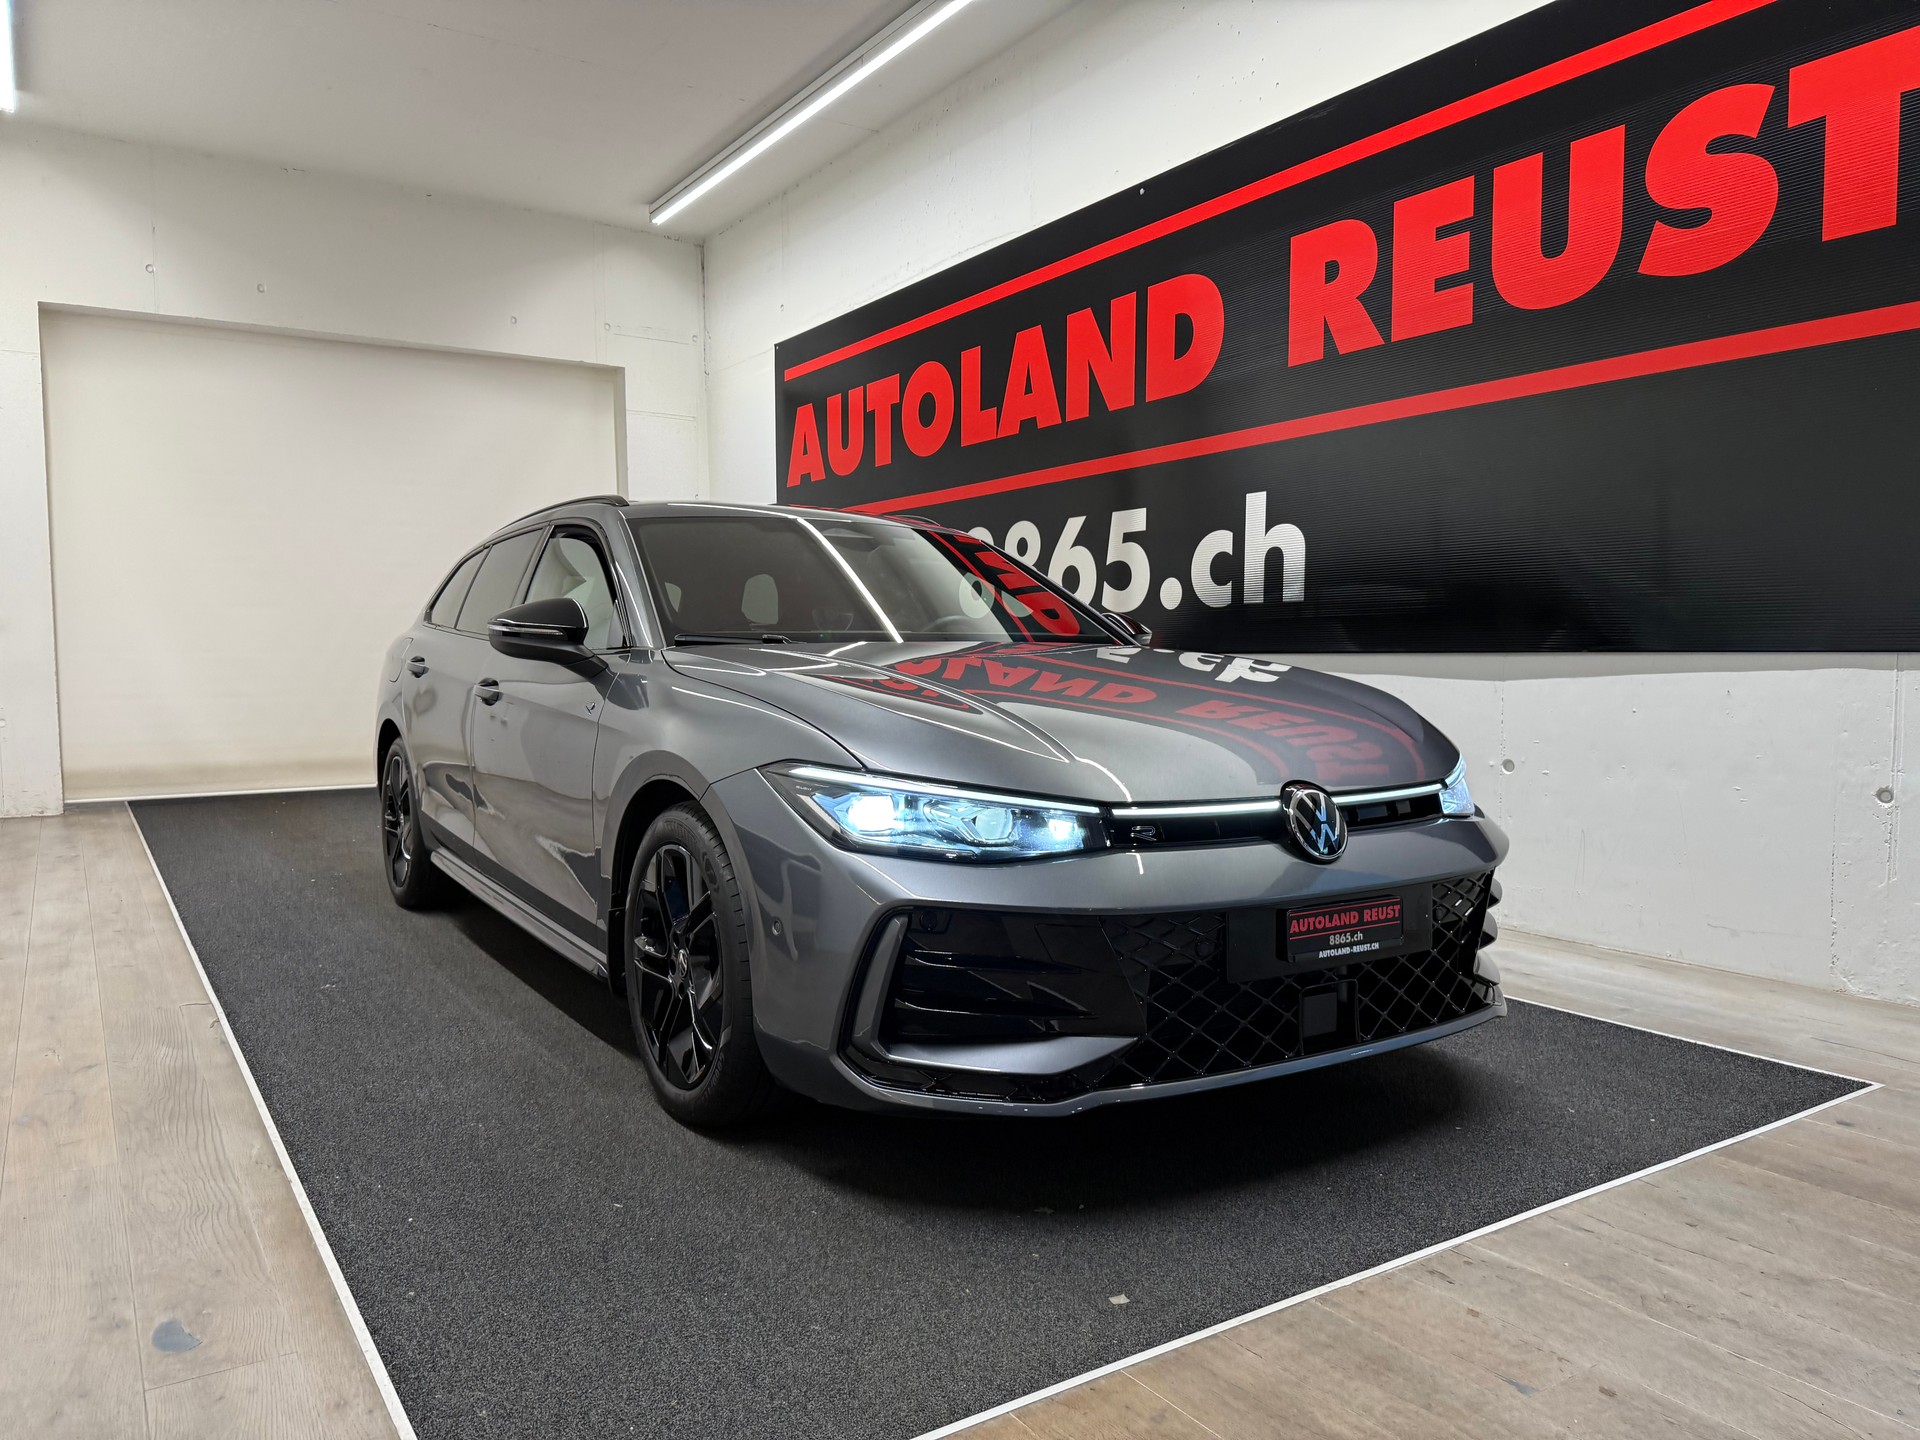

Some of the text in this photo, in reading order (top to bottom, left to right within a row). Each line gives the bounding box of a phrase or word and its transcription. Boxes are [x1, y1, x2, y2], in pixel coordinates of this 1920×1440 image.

[786, 25, 1920, 488] AUTOLAND REUST
[1290, 905, 1401, 934] AUTOLAND REUST
[1329, 931, 1364, 946] 8865.ch
[1318, 942, 1380, 959] AUTOLAND-REUST.CH
